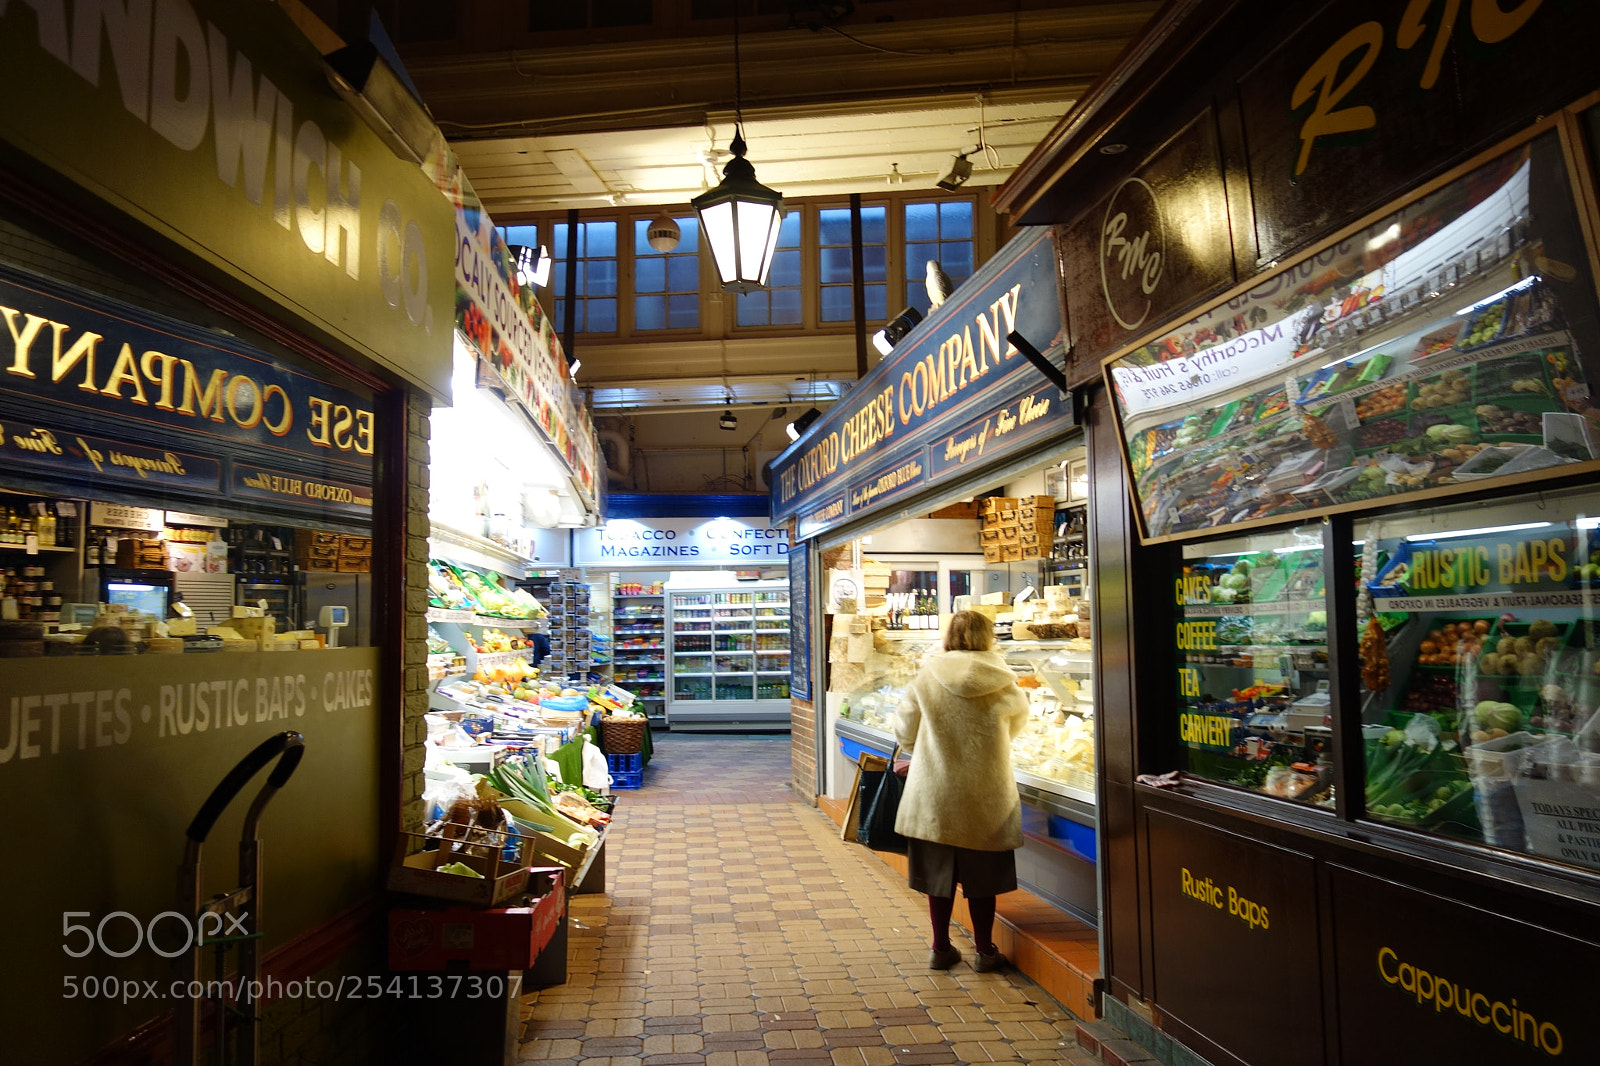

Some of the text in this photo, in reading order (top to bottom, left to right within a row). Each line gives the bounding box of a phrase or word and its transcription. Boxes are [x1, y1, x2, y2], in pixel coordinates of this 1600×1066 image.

[494, 282, 533, 367] SOURCED
[780, 283, 1022, 504] THE OXFORD CHEESE COMPANY
[977, 419, 991, 456] of
[994, 409, 1017, 437] Fine
[595, 527, 677, 541] TACCO
[600, 544, 700, 558] MAGAZINES
[729, 543, 772, 556] SOFT
[1412, 537, 1567, 591] RUSTIC BAPS
[1174, 573, 1212, 606] CAKES
[1176, 619, 1217, 651] COFFEE
[1178, 667, 1201, 698] TEA
[0, 668, 374, 765] UETTES RUSTIC BAPS CAKES
[1179, 711, 1233, 748] CARVERY
[1531, 802, 1572, 817] TODAYS
[1557, 819, 1577, 831] ALL
[1561, 847, 1589, 861] ONLY
[1180, 866, 1270, 931] Rustic Baps
[1377, 945, 1564, 1057] Cappuccino
